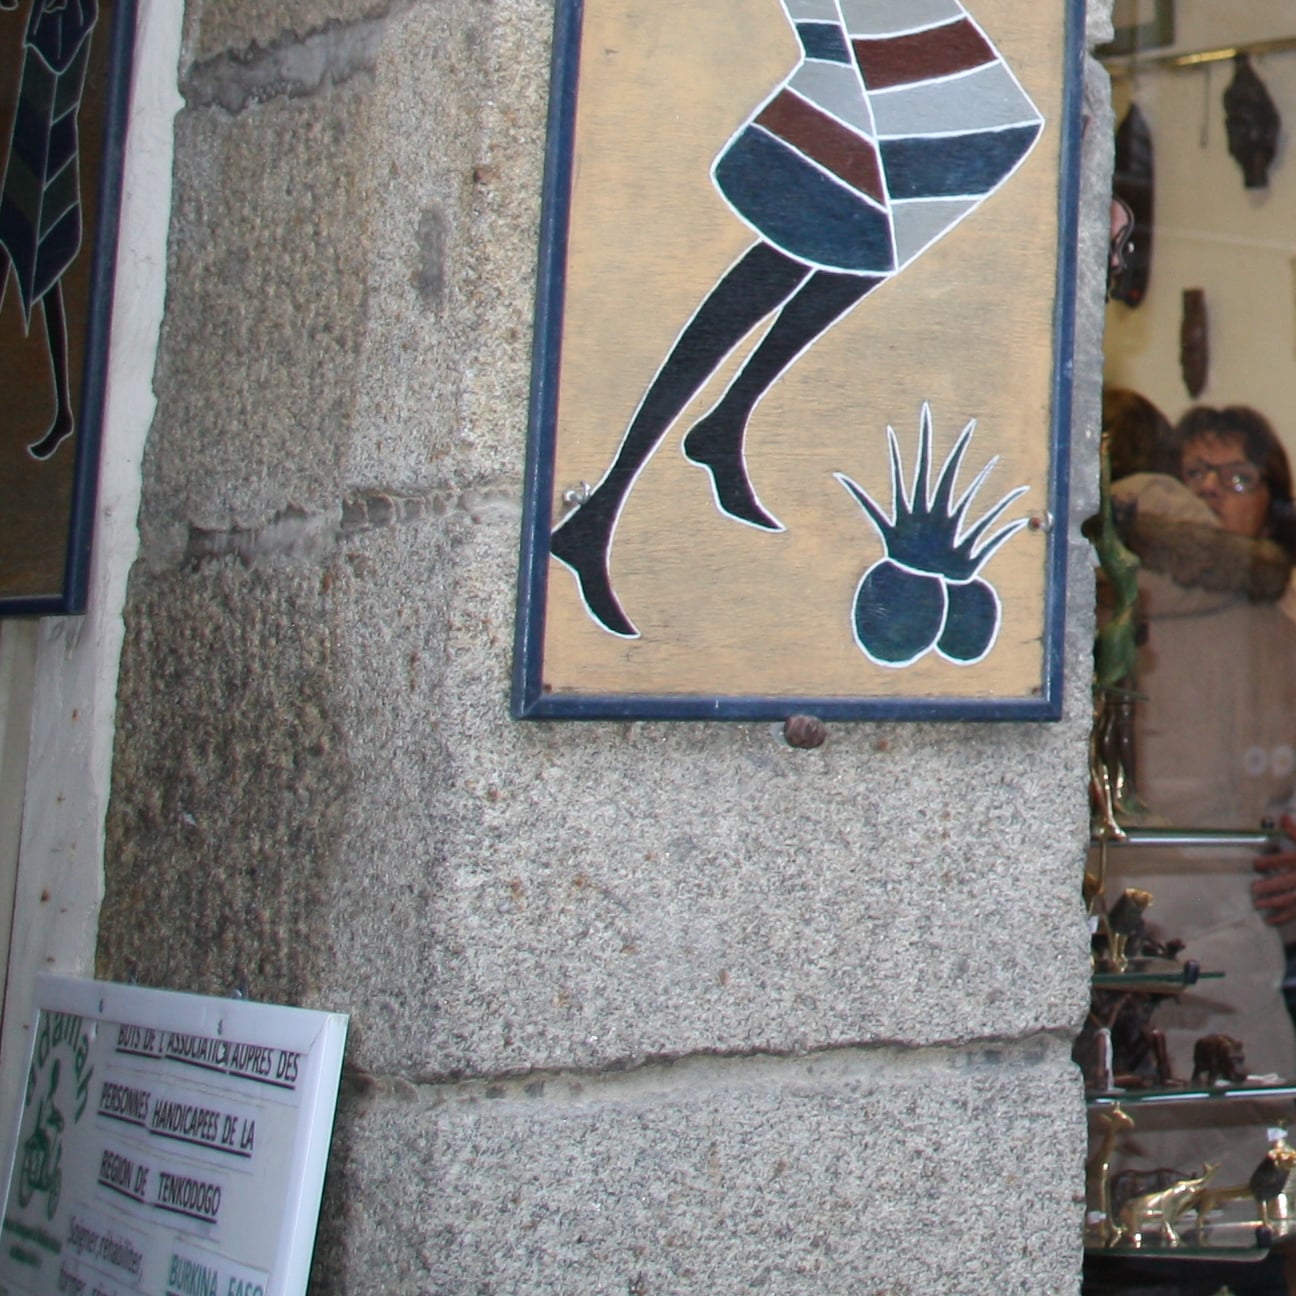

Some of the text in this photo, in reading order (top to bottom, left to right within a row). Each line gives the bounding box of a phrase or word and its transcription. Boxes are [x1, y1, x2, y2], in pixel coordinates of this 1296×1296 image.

[276, 1052, 300, 1082] DES
[101, 1082, 256, 1151] PERSONNES HANDICAPEES DE LA
[102, 1150, 222, 1216] REGION DE TENKODOGO
